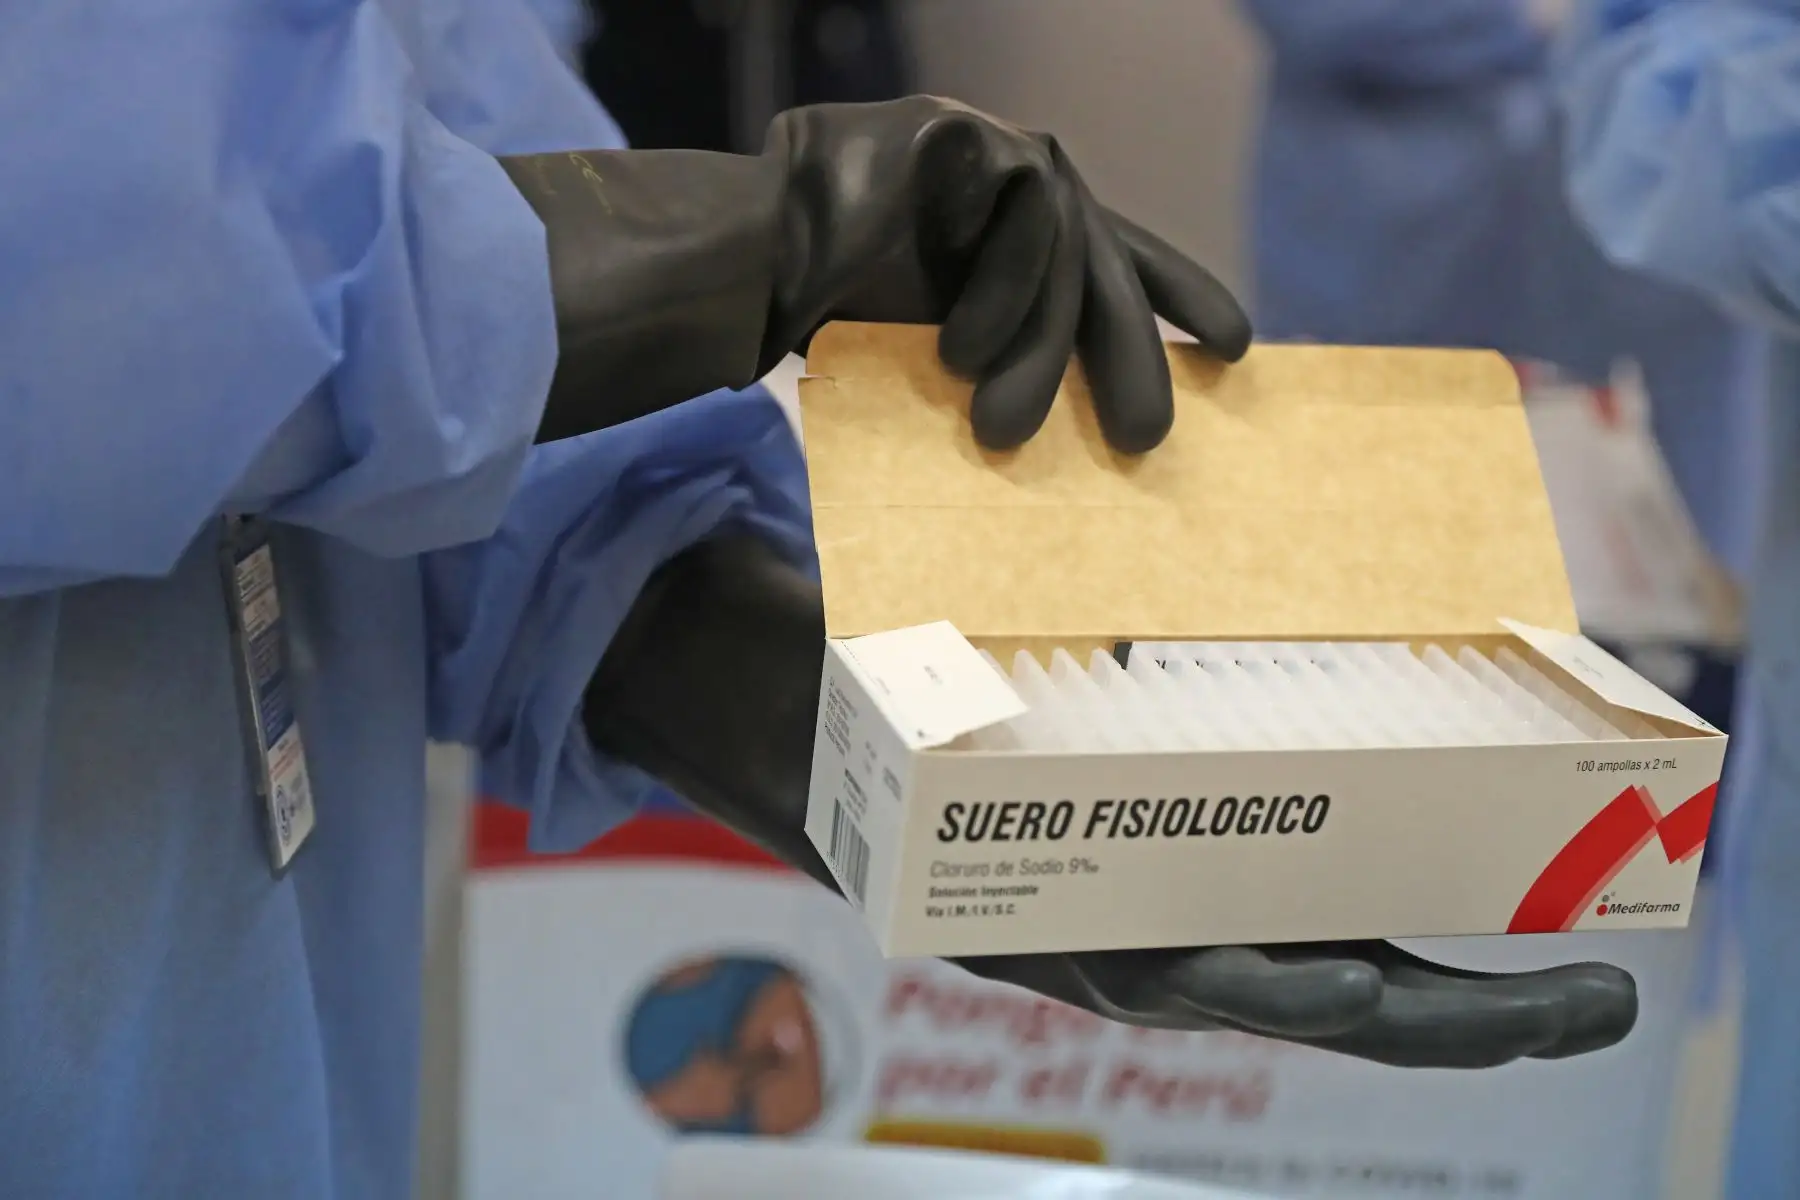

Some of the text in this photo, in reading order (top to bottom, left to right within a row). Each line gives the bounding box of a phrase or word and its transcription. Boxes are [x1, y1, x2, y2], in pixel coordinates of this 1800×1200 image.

[1576, 758, 1677, 772] 100 ampollas x 2 mL
[937, 795, 1331, 842] SUERO FISIOLOGICO
[930, 860, 991, 878] Cloruro
[994, 860, 1014, 876] de
[1019, 858, 1064, 876] Sodio
[1608, 902, 1681, 914] Medifarma
